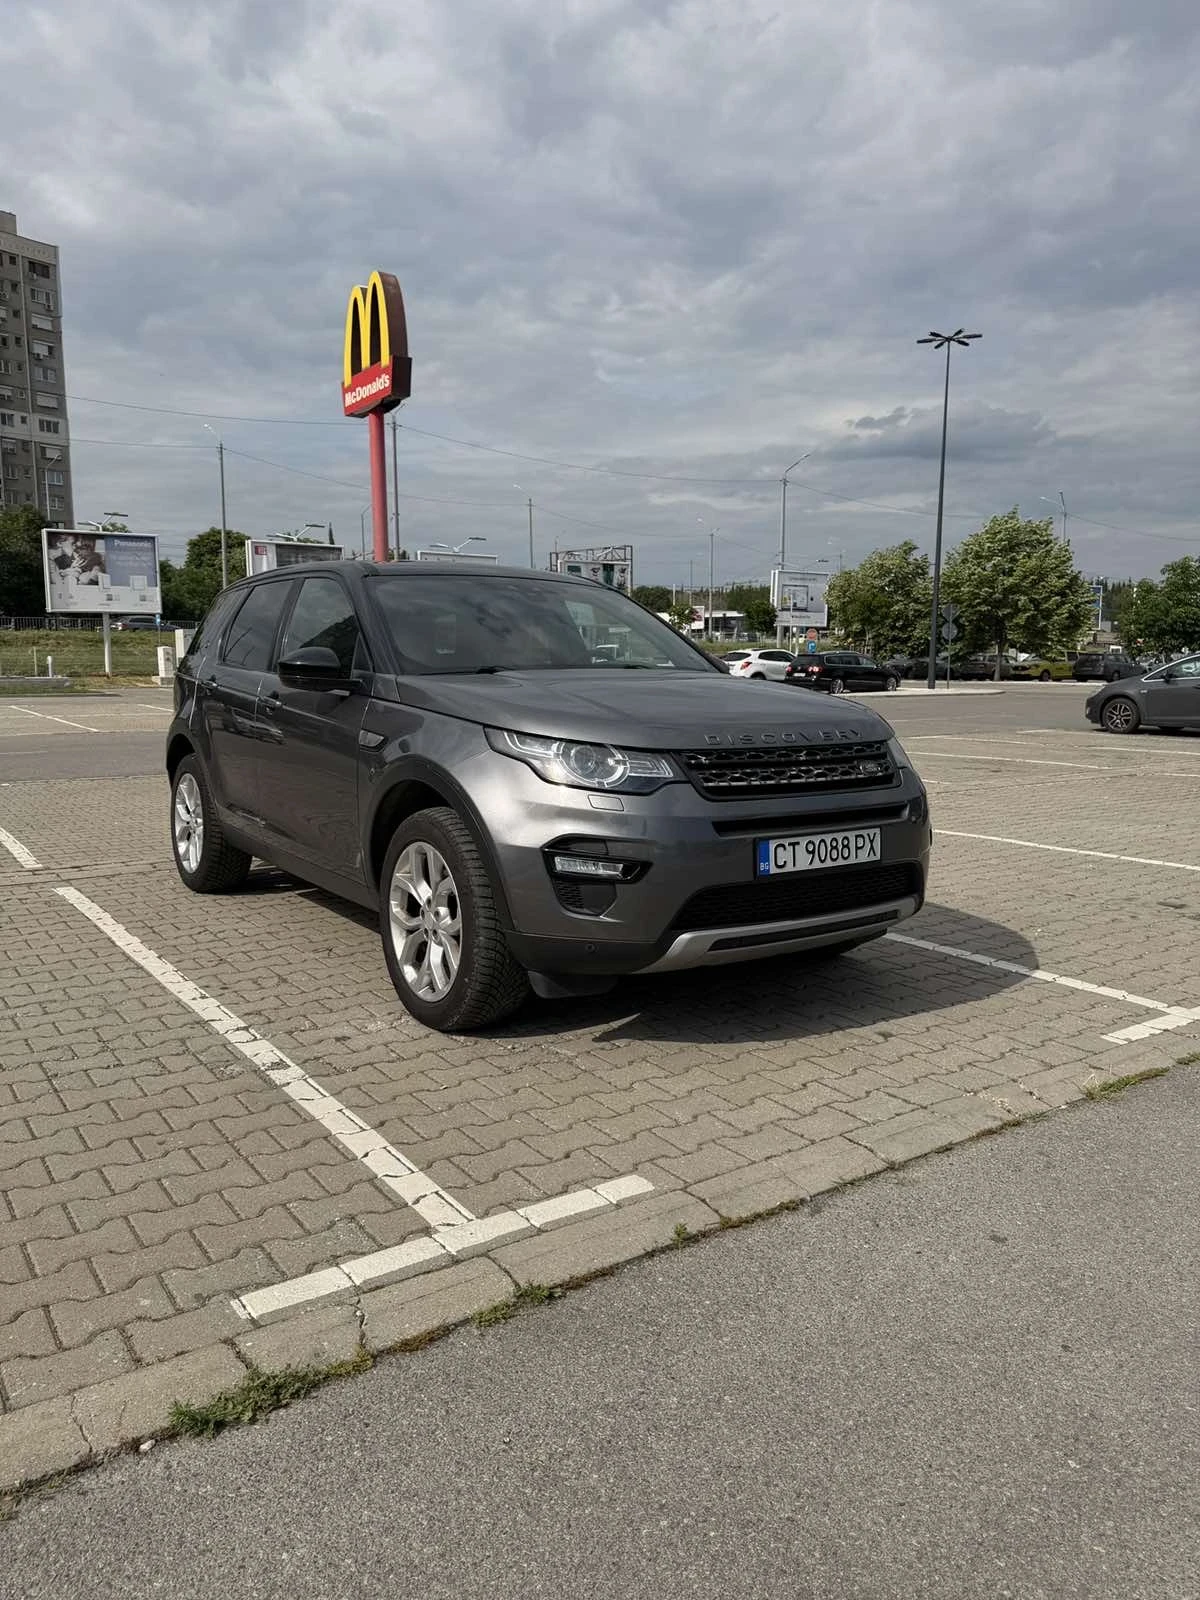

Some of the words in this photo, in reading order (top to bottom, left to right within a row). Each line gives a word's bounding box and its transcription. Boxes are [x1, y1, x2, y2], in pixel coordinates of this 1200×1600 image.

[344, 373, 390, 408] McDonald's
[704, 728, 863, 746] DISCOVERY
[773, 841, 800, 869] CT
[805, 836, 851, 866] 9088
[854, 832, 877, 860] PX
[759, 862, 769, 871] BG
